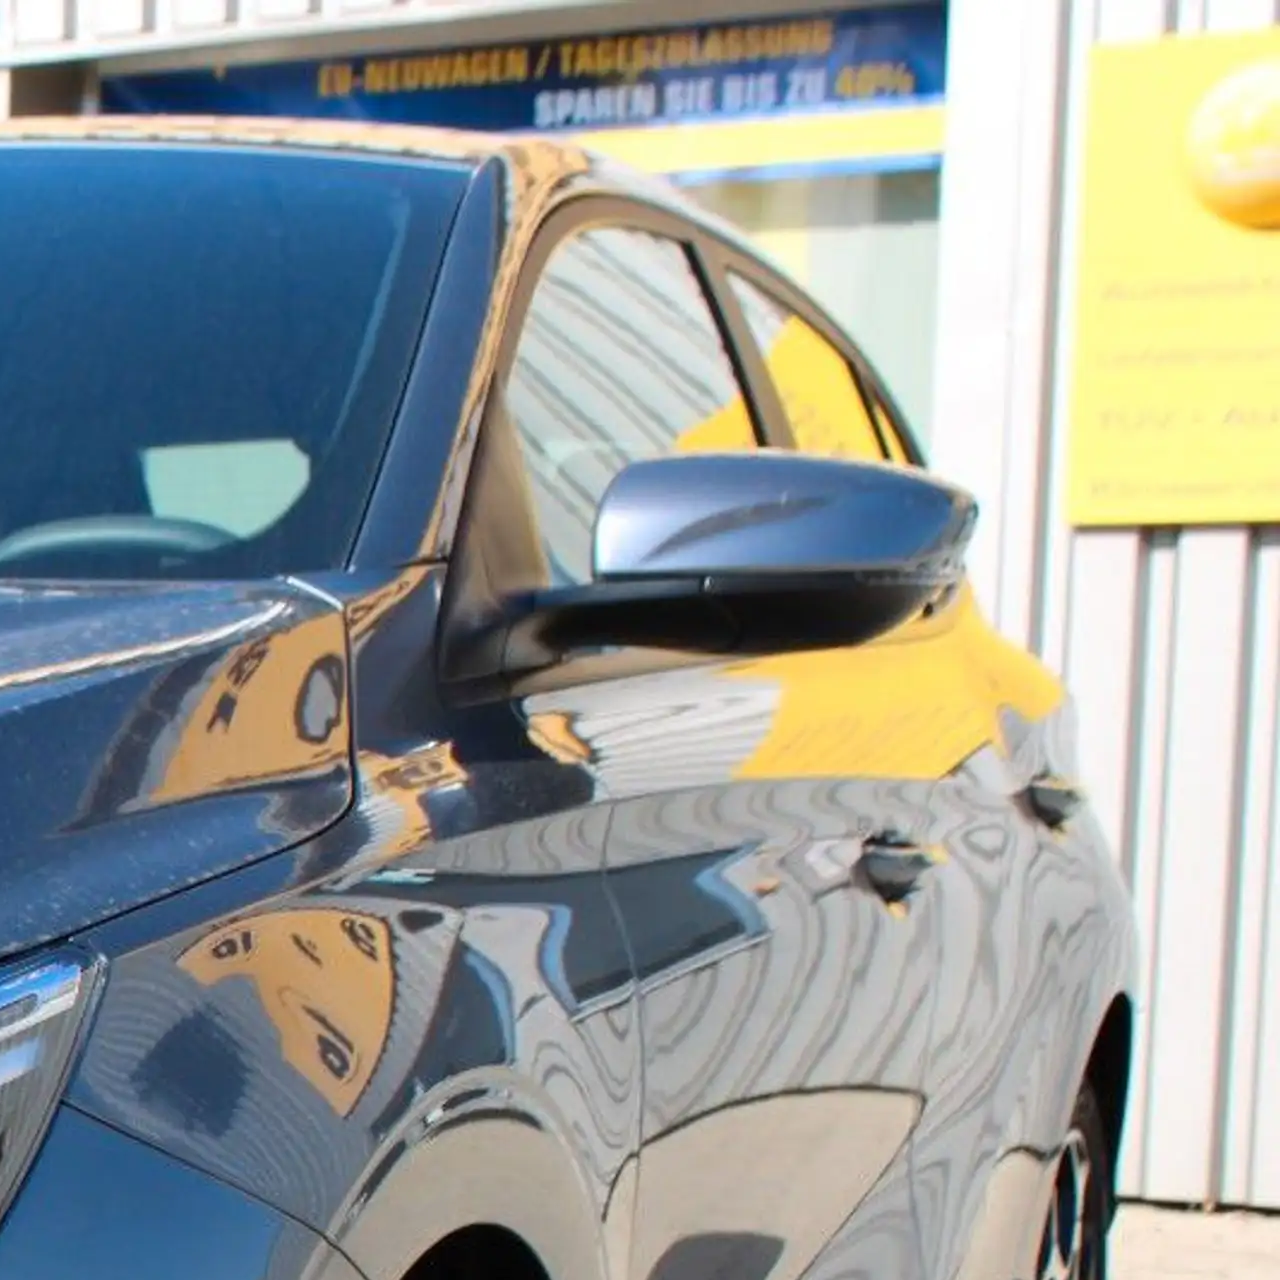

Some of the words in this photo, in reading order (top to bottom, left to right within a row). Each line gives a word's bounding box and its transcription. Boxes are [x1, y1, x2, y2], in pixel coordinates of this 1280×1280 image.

[317, 48, 529, 96] EU-NEUWAGEN
[560, 21, 833, 74] TAGESZULASSUNG
[532, 81, 658, 129] SPAREN
[661, 76, 715, 118] SIE
[720, 71, 779, 113] BIS
[785, 67, 829, 105] ZU
